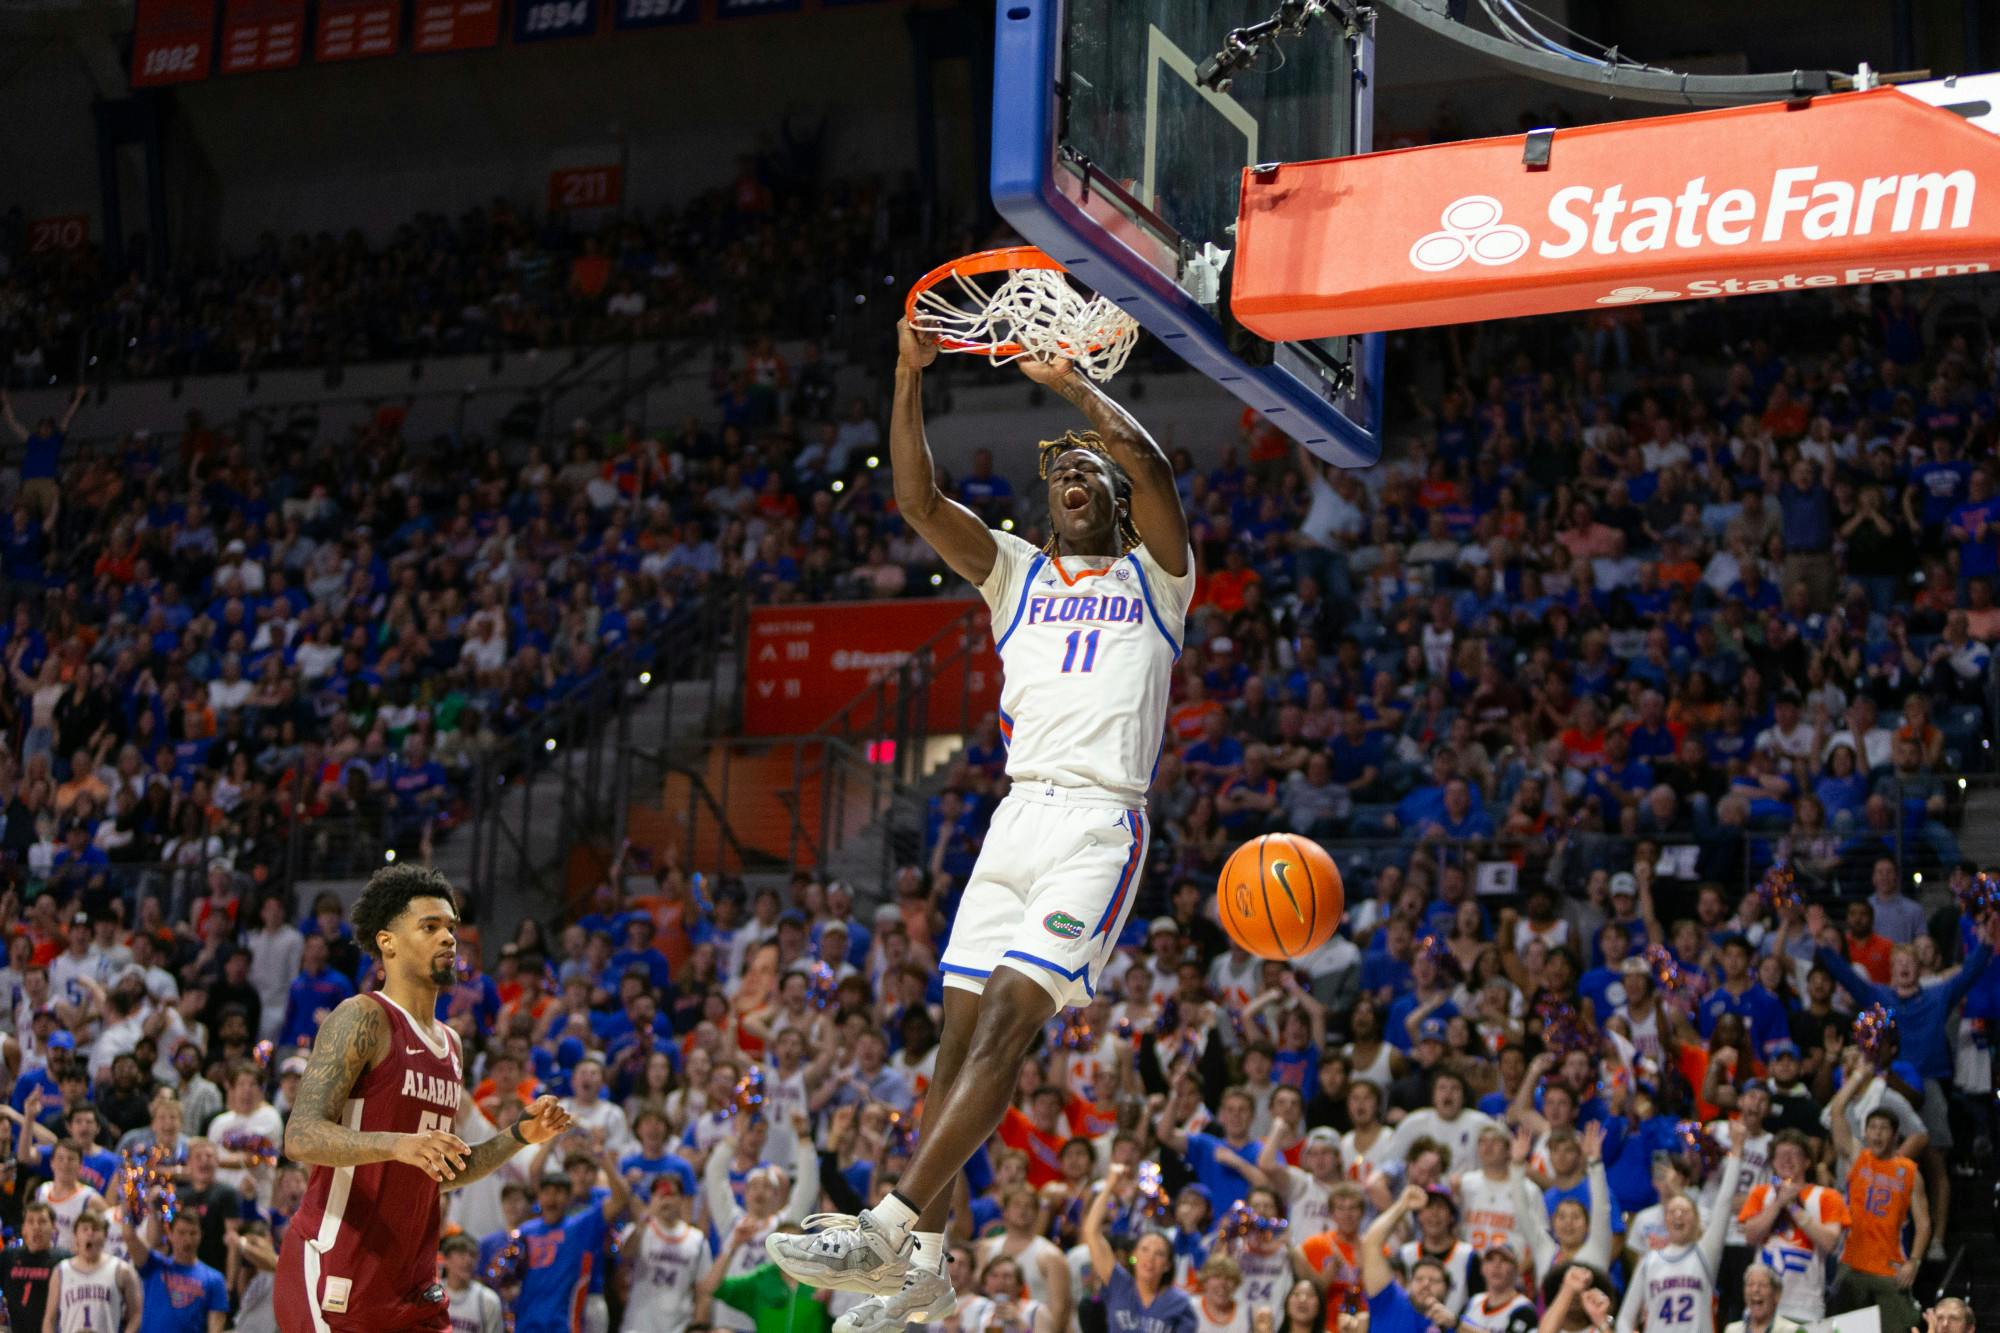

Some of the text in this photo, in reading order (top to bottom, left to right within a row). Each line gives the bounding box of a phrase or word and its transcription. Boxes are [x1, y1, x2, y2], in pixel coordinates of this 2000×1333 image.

[1687, 263, 1990, 296] State Farm
[1027, 595, 1143, 625] FLORIDA
[1060, 629, 1101, 673] 11
[65, 1285, 112, 1308] FLORIDA
[1659, 1294, 1694, 1324] 42
